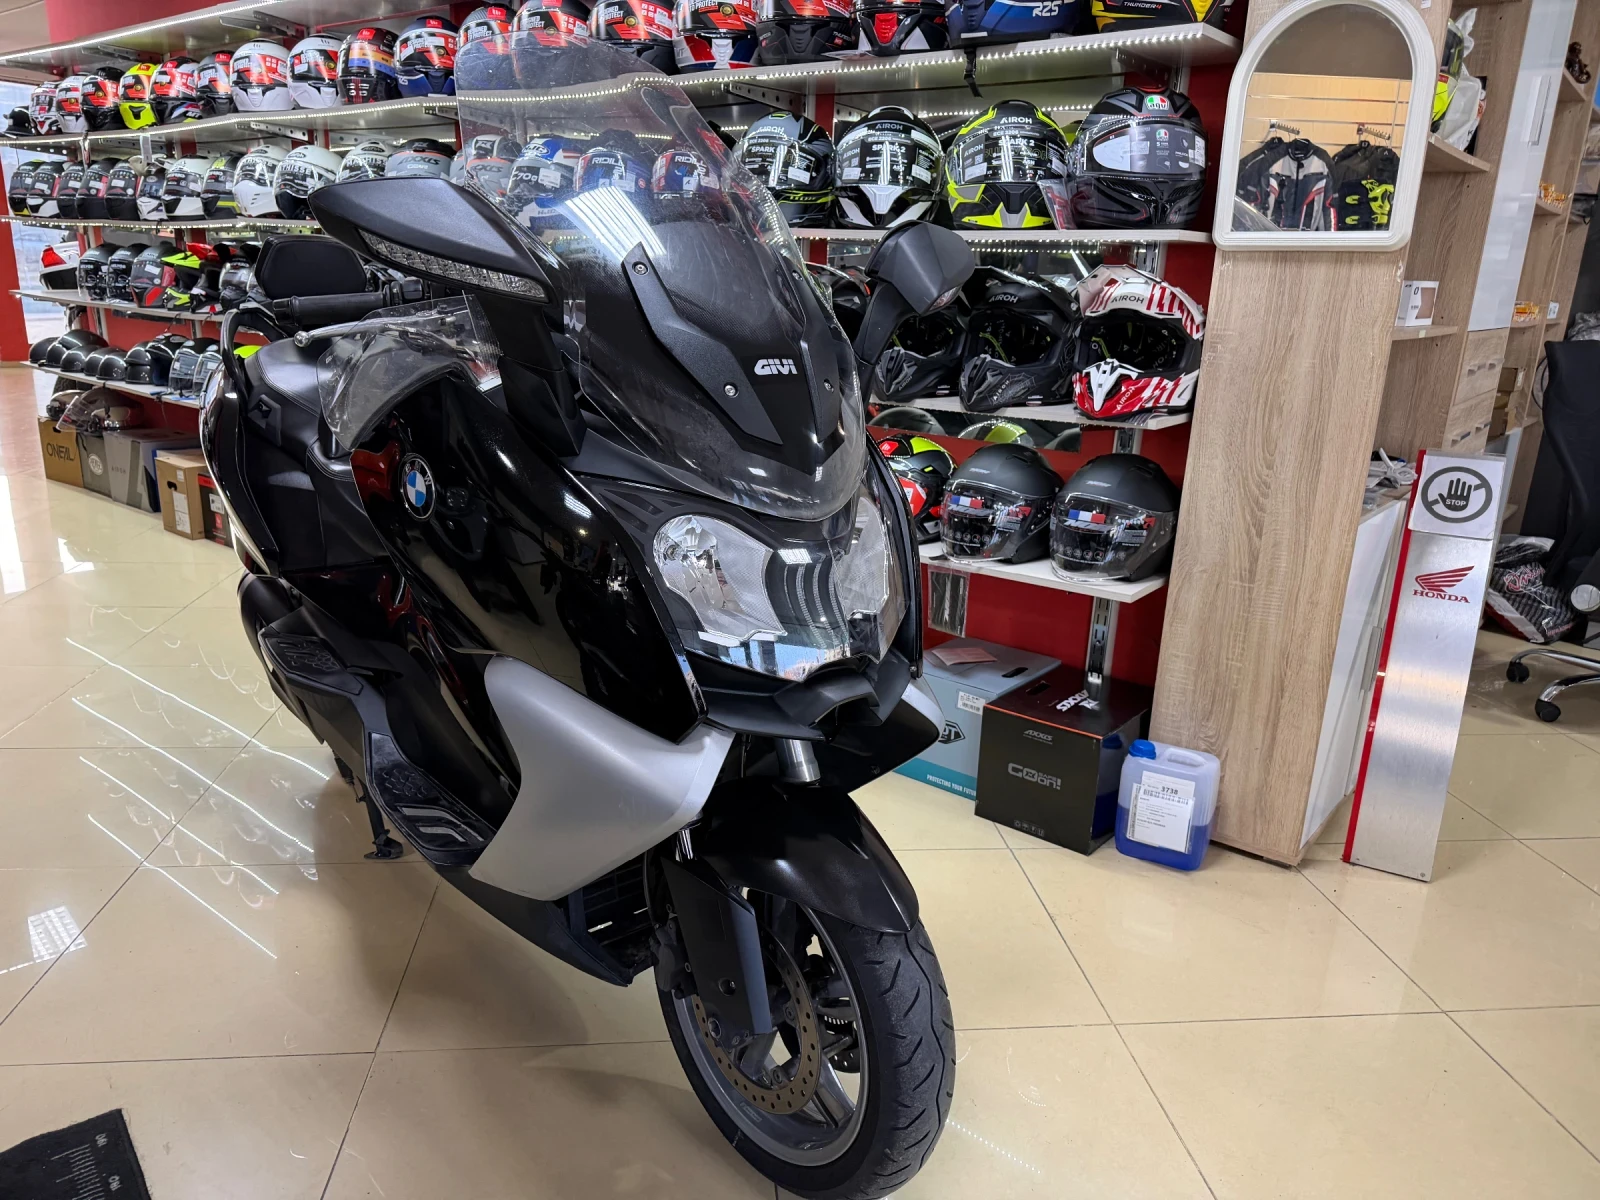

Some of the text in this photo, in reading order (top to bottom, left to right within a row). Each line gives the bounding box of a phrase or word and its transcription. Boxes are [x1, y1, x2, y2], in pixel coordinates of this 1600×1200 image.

[1000, 116, 1032, 124] AIROH
[964, 143, 984, 157] AIROH
[989, 293, 1019, 304] AIROH
[1110, 294, 1145, 304] AIROH
[753, 358, 798, 376] GIVI
[1116, 385, 1137, 410] AIROH
[1445, 498, 1467, 507] STOP
[1412, 588, 1471, 604] HONDA
[1023, 729, 1053, 741] AXXIS
[926, 773, 952, 788] PROTECTING
[951, 782, 964, 792] YOUR
[1160, 785, 1179, 796] 3738
